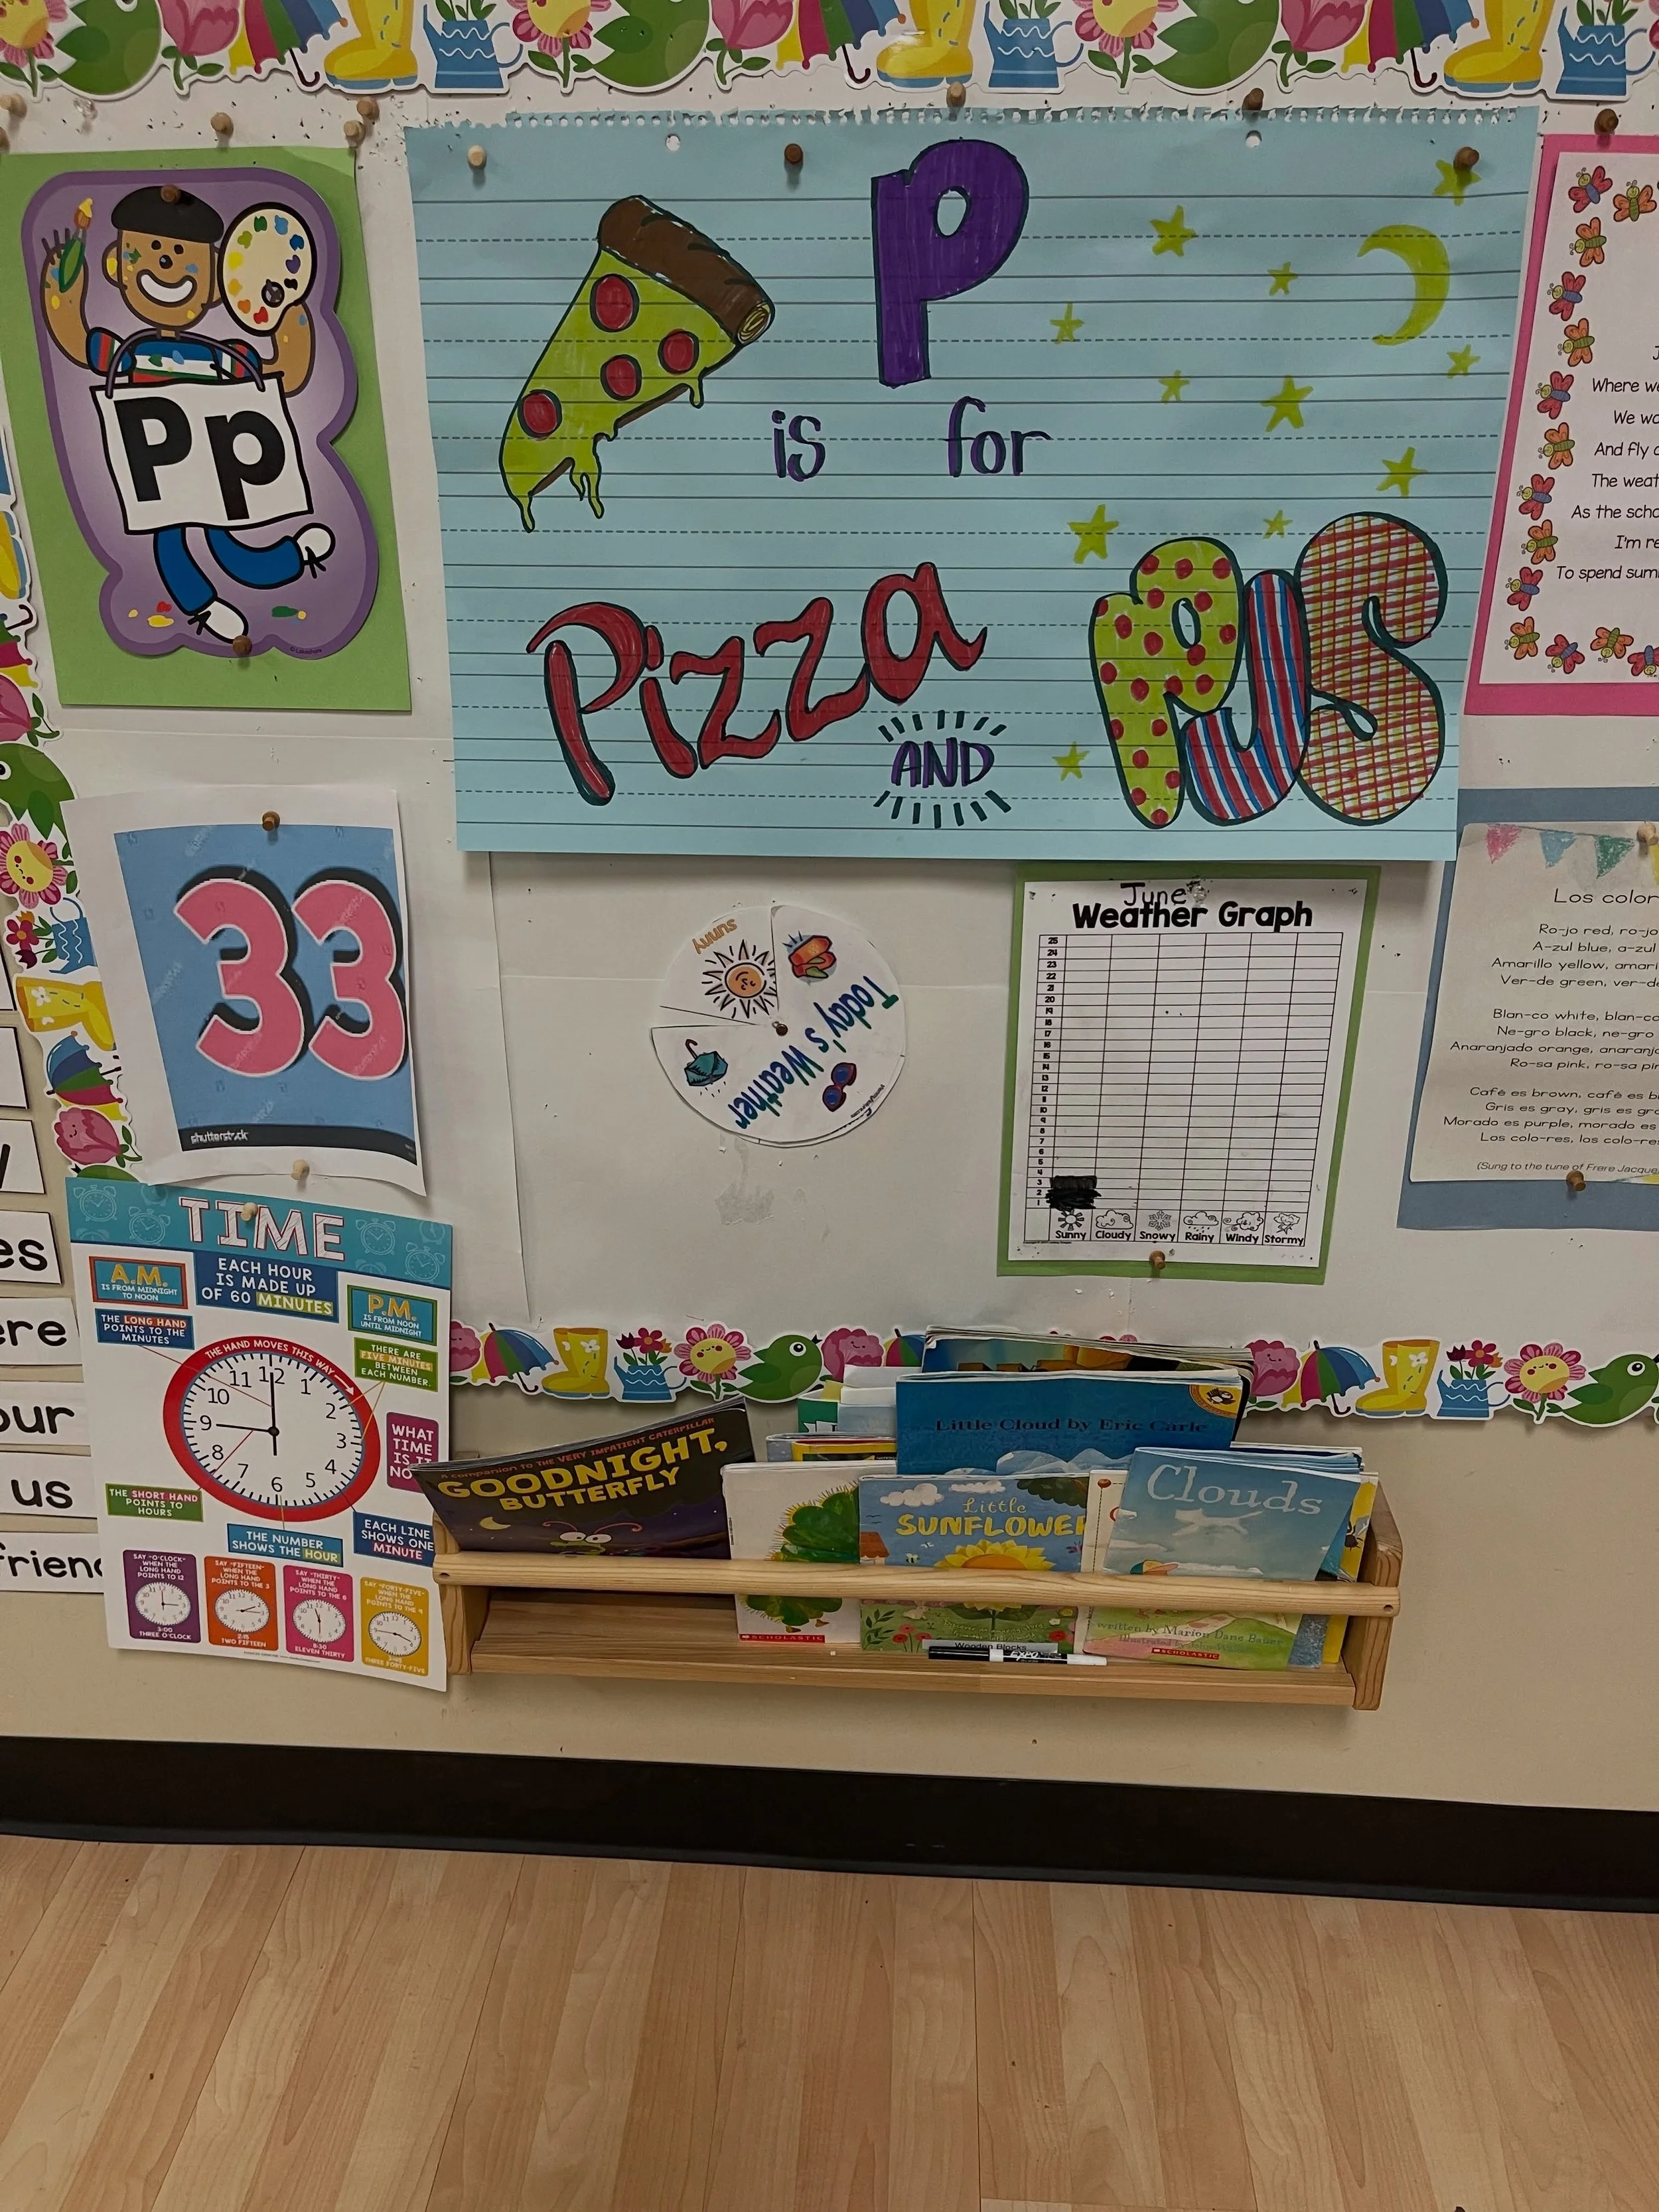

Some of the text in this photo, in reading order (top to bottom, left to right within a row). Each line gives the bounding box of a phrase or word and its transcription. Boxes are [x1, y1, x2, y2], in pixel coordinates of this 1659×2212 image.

[871, 137, 1029, 388] P
[1592, 378, 1640, 392] Where
[1614, 409, 1635, 425] We
[770, 396, 1052, 482] is for
[113, 396, 286, 521] Pp
[1594, 441, 1624, 456] And
[1628, 441, 1650, 460] fly
[1592, 473, 1618, 488] The
[1571, 504, 1591, 519] As
[1595, 504, 1621, 519] the
[1614, 535, 1641, 549] I'm
[1557, 565, 1623, 582] To spend
[527, 561, 989, 806] Pizza
[890, 739, 995, 788] AND
[1119, 881, 1187, 907] June
[1554, 888, 1594, 904] Los
[1072, 901, 1313, 932] Weather Graph
[1538, 923, 1578, 937] Ro-jo
[1583, 924, 1614, 936] red,
[1532, 941, 1656, 954] A-zul blue, a-zul
[1492, 958, 1609, 971] Amarillo yellow,
[173, 867, 407, 1080] 33
[1500, 974, 1607, 988] Ver-de green,
[804, 975, 899, 1053] Today's
[1493, 1008, 1599, 1021] Blan-co white,
[1497, 1025, 1654, 1041] Ne-gro black, ne-gro
[1450, 1041, 1593, 1056] Anaranjado orange,
[727, 1045, 824, 1130] Weather
[1470, 1086, 1506, 1097] Café
[1532, 1088, 1581, 1099] brown,
[1485, 1102, 1514, 1112] Gris
[1540, 1106, 1577, 1116] gray,
[1443, 1116, 1499, 1127] Morado
[1524, 1119, 1573, 1130] purple,
[1480, 1132, 1573, 1144] Los colo-res,
[178, 1196, 345, 1262] TIME
[1055, 1230, 1305, 1246] Sunny Cloudy Snowy Rainy Windy Stormy
[110, 1263, 169, 1288] A.M.
[218, 1257, 313, 1282] EACH HOUR
[137, 1287, 178, 1296] MIDNIGHT
[216, 1272, 316, 1297] IS MADE UP
[201, 1287, 332, 1315] OF 60 MINUTES
[368, 1293, 417, 1321] P.M.
[101, 1314, 186, 1328] THE LONG HAND
[360, 1321, 422, 1337] UNTIL MIDNIGHT
[373, 1315, 396, 1325] FROM
[397, 1319, 419, 1329] NOON
[104, 1323, 185, 1337] POINTS TO THE
[121, 1333, 170, 1345] MINUTES
[204, 1339, 336, 1376] THE HAND MOVES THIS WAY
[371, 1344, 421, 1360] THERE ARE
[360, 1351, 431, 1370] FIVE MINUTES
[375, 1361, 418, 1376] BETWEEN
[229, 1370, 252, 1388] 11
[258, 1366, 285, 1385] 12
[361, 1367, 431, 1387] EACH NUMBER.
[206, 1387, 230, 1405] 10
[392, 1423, 434, 1442] WHAT
[936, 1418, 1207, 1433] Little Cloud by Eric Carle
[336, 1433, 347, 1449] 3
[393, 1438, 433, 1456] TIME
[536, 1458, 555, 1467] THE
[557, 1449, 587, 1463] VERY
[590, 1436, 646, 1457] IMPATIENT
[648, 1417, 715, 1441] CATERPILLAR
[394, 1451, 410, 1465] IS
[437, 1428, 728, 1499] GOODNIGHT,
[271, 1477, 283, 1493] 6
[499, 1466, 680, 1511] BUTTERFLY
[1147, 1464, 1323, 1514] Clouds
[11, 1479, 73, 1509] us
[109, 1489, 198, 1503] THE SHORT HAND
[125, 1499, 183, 1510] POINTS TO
[137, 1507, 173, 1517] HOURS
[963, 1497, 1027, 1514] Little
[1096, 1621, 1143, 1633] written
[1145, 1623, 1158, 1636] by
[1163, 1625, 1210, 1638] Marion
[1214, 1629, 1244, 1643] Dane
[1009, 1650, 1039, 1661] EXPO
[1161, 1649, 1218, 1659] SCHOLASTIC
